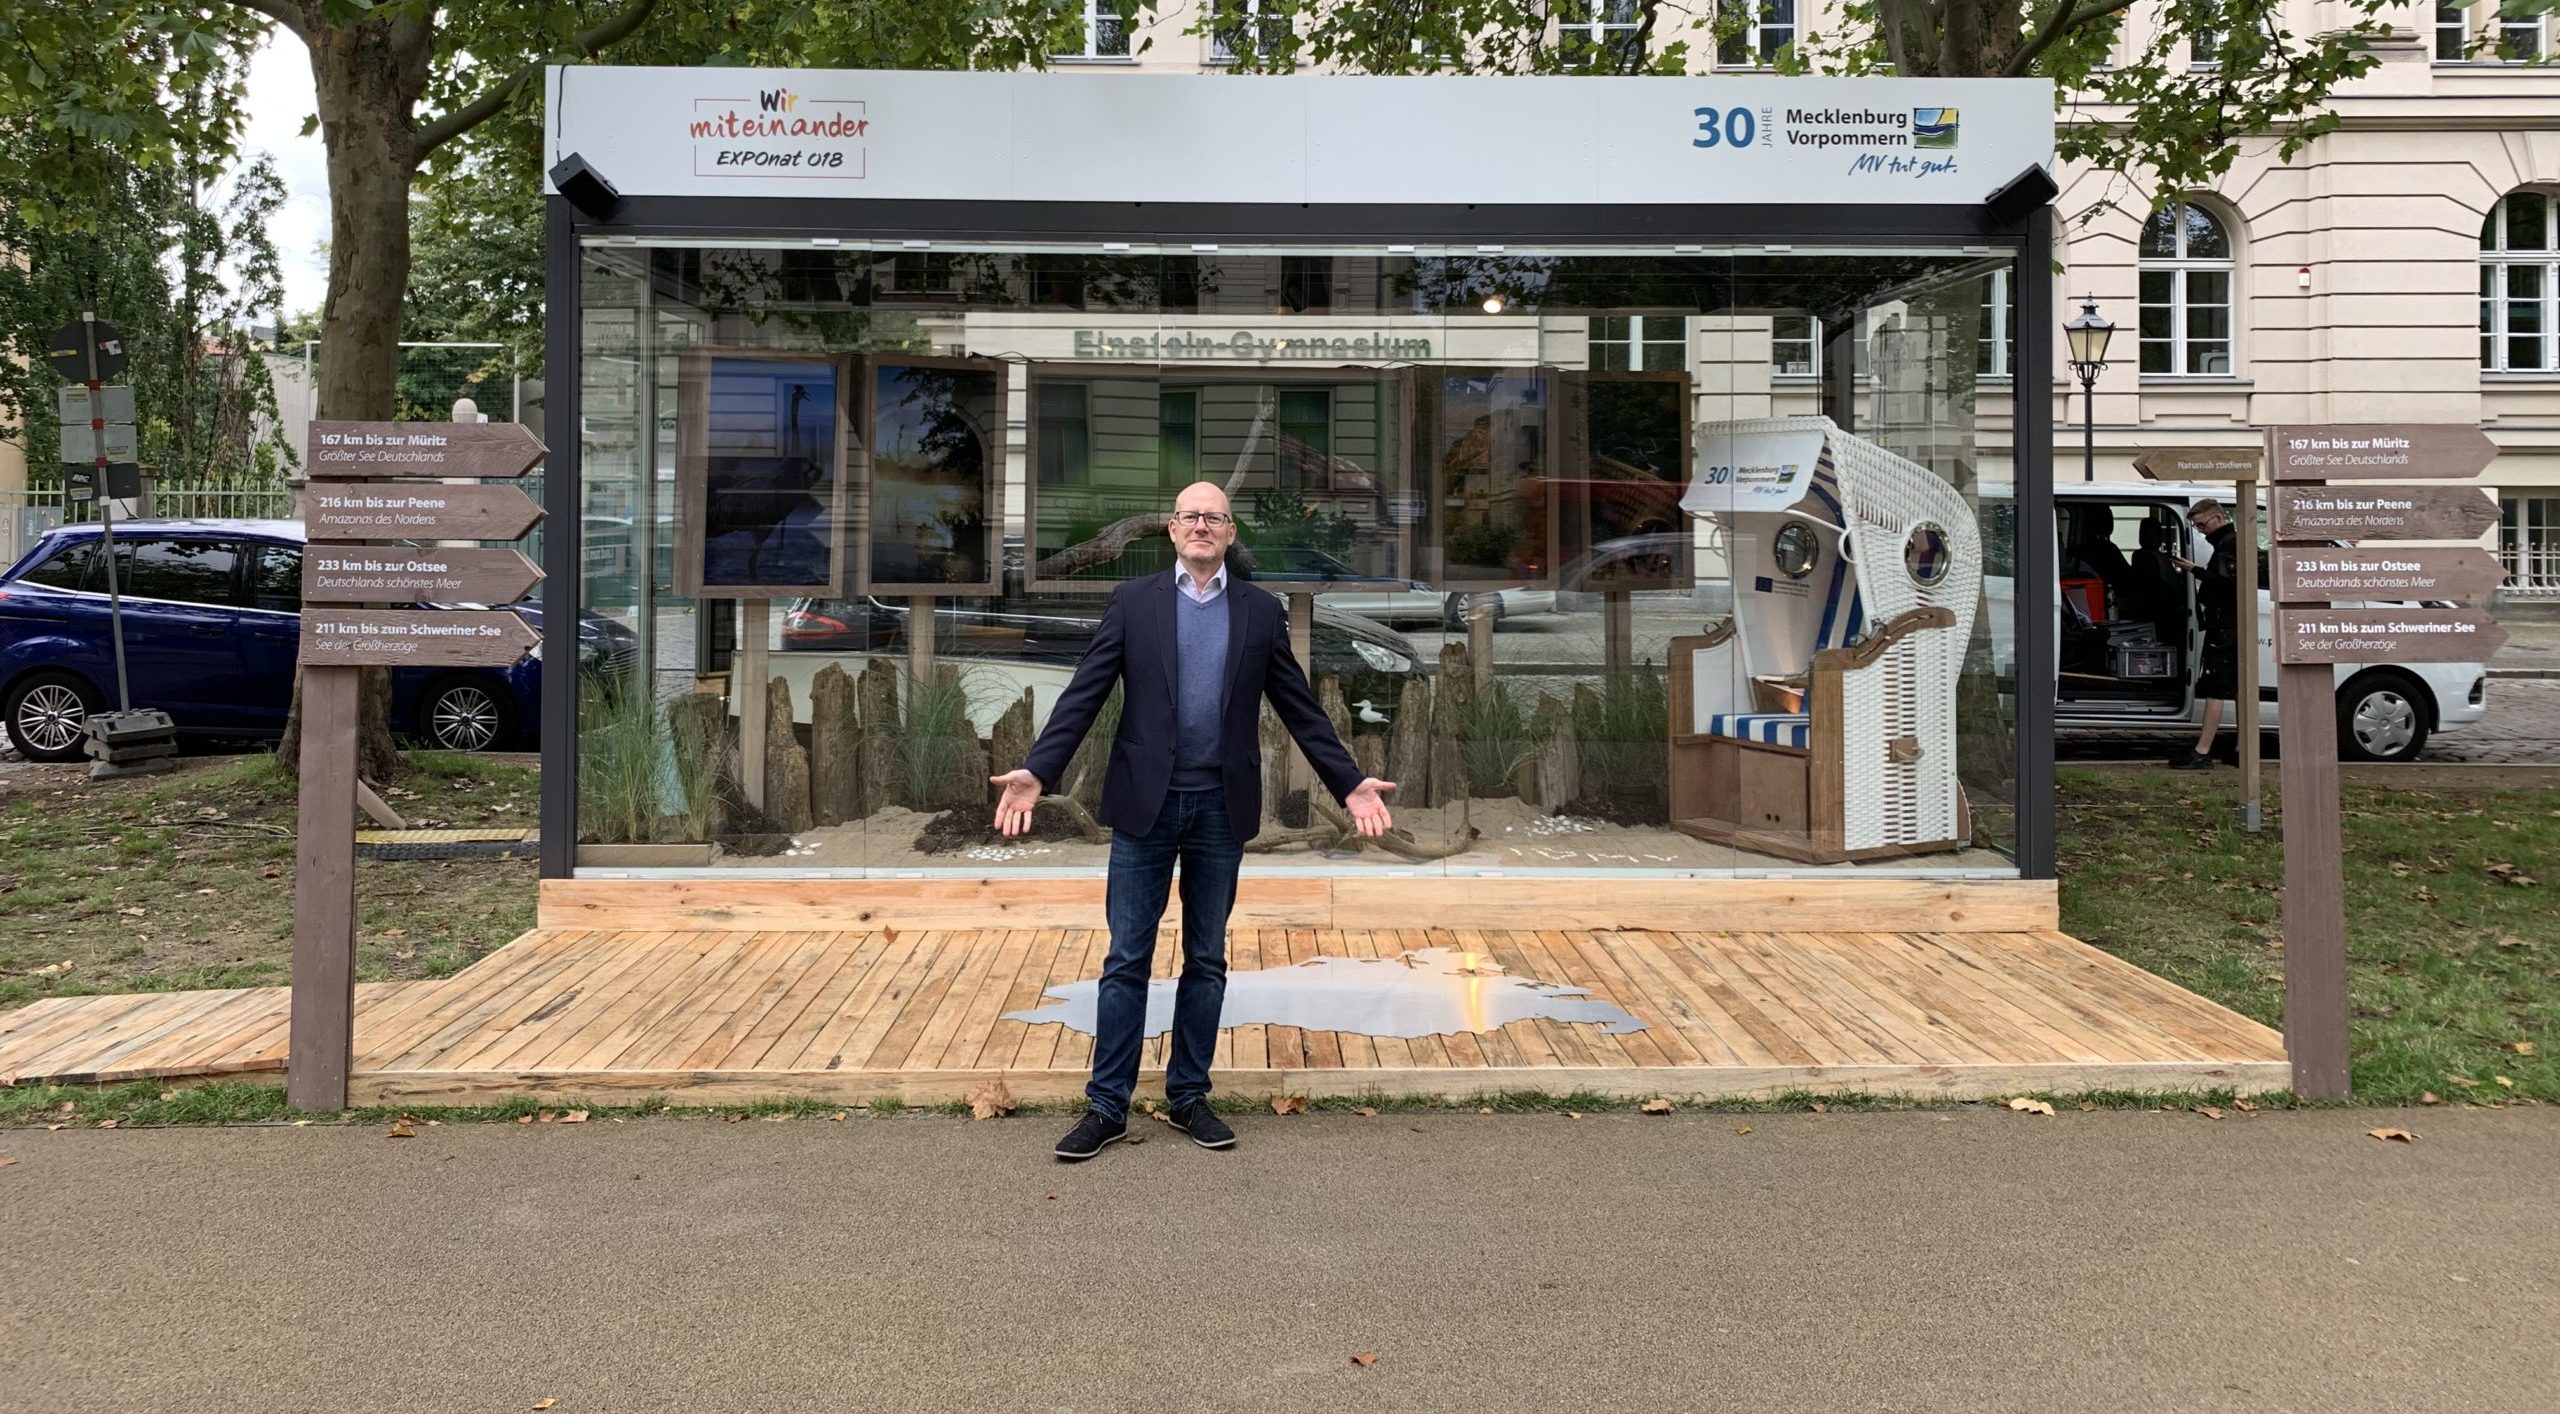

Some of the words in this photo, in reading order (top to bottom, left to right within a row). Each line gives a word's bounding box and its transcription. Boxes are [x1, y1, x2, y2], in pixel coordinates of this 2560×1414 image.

[760, 88, 800, 112] Wir
[690, 110, 870, 139] miteinander
[1786, 108, 1908, 128] Mecklenburg
[1692, 106, 1756, 149] 30
[1761, 106, 1774, 149] JAHRE
[1786, 130, 1908, 149] Vorpommern
[716, 150, 803, 167] EXPOnat
[1847, 152, 1888, 176] MV
[1888, 155, 1916, 175] tut
[1073, 329, 1432, 364] Einstein-Gymnasium
[320, 434, 342, 446] 167
[343, 434, 364, 446] km
[365, 434, 384, 446] bis
[385, 436, 406, 446] zur
[407, 433, 448, 447] Müritz
[2289, 438, 2309, 450] 167
[2311, 438, 2330, 450] km
[2332, 438, 2349, 449] bis
[2351, 440, 2370, 449] zur
[2372, 436, 2410, 449] Müritz
[319, 450, 357, 462] Größter
[358, 450, 376, 462] See
[377, 450, 445, 463] Deutschlands
[2289, 454, 2325, 467] Größter
[2327, 454, 2343, 466] See
[2345, 453, 2409, 466] Deutschlands
[1704, 466, 1729, 484] 30
[320, 497, 342, 508] 216
[344, 497, 364, 508] km
[365, 497, 384, 508] bis
[387, 500, 407, 508] zur
[408, 497, 446, 508] Peene
[2293, 499, 2313, 511] 216
[2315, 499, 2334, 510] km
[2336, 499, 2353, 510] bis
[2356, 501, 2374, 510] zur
[2376, 499, 2412, 510] Peene
[318, 513, 373, 525] Amazonas
[375, 513, 393, 525] des
[394, 514, 436, 525] Nordens
[2293, 515, 2346, 527] Amazonas
[2347, 515, 2363, 526] des
[2365, 514, 2404, 526] Nordens
[317, 560, 340, 571] 233
[342, 560, 362, 571] km
[365, 560, 383, 572] bis
[385, 563, 405, 572] zur
[407, 561, 448, 573] Ostsee
[2296, 561, 2317, 572] 233
[2319, 561, 2339, 572] km
[2341, 561, 2358, 571] bis
[2360, 562, 2380, 571] zur
[2382, 560, 2421, 571] Ostsee
[317, 576, 384, 588] Deutschlands
[386, 577, 434, 589] schönstes
[436, 579, 463, 589] Meer
[2296, 577, 2361, 588] Deutschlands
[2363, 577, 2409, 588] schönstes
[2411, 577, 2436, 588] Meer
[315, 623, 336, 634] 211
[338, 623, 359, 634] km
[361, 623, 378, 635] bis
[380, 626, 407, 635] zum
[409, 624, 477, 636] Schweriner
[479, 625, 502, 636] See
[2298, 623, 2317, 634] 211
[2320, 623, 2339, 633] km
[2341, 622, 2358, 633] bis
[2360, 624, 2385, 633] zum
[2388, 622, 2453, 633] Schweriner
[2454, 622, 2476, 633] See
[315, 639, 333, 650] See
[334, 639, 351, 651] der
[352, 639, 419, 653] Großherzöge
[2299, 639, 2316, 650] See
[2318, 639, 2334, 650] der
[2335, 639, 2397, 652] Großherzöge
